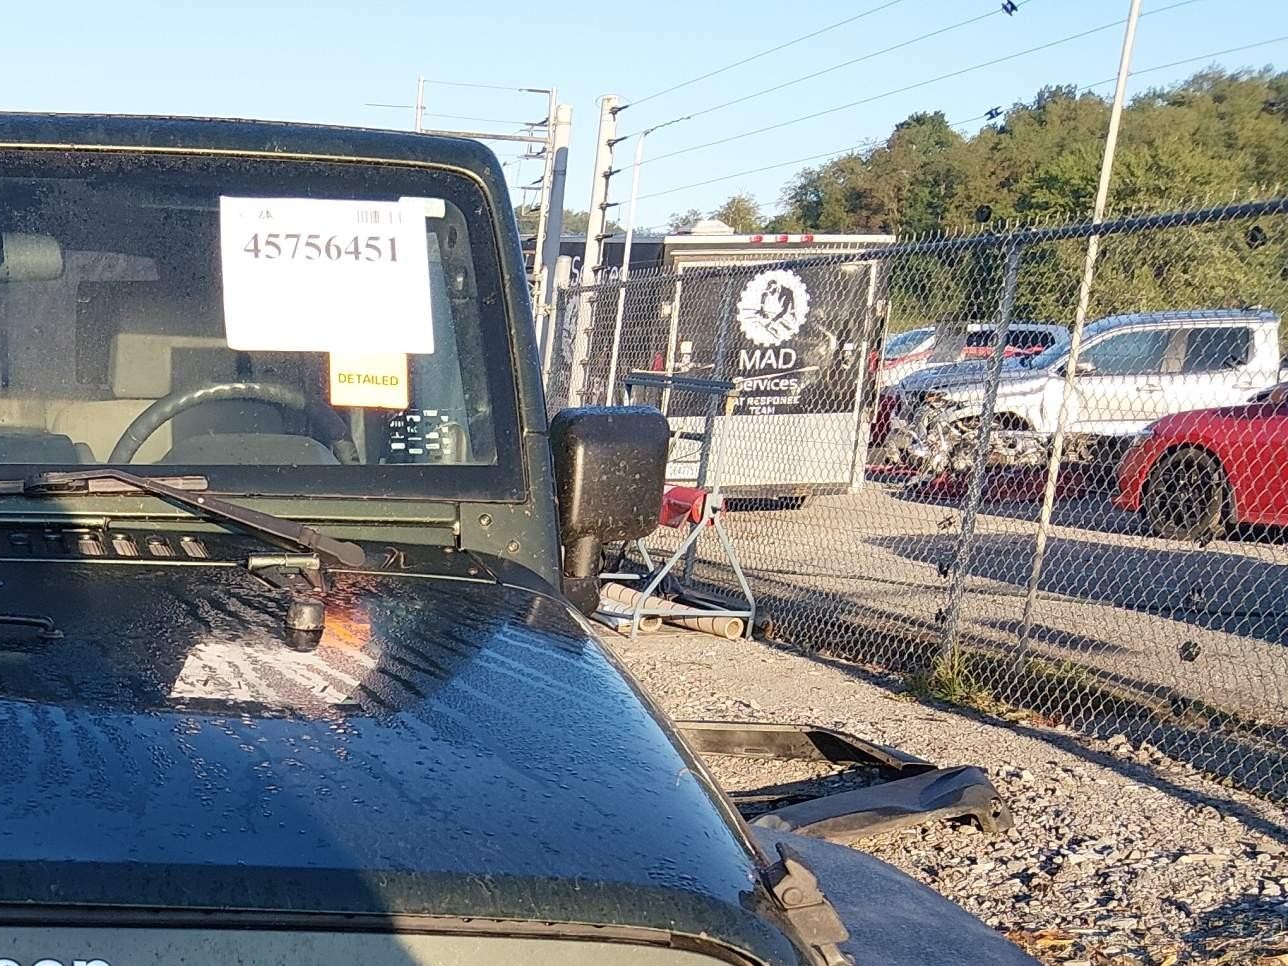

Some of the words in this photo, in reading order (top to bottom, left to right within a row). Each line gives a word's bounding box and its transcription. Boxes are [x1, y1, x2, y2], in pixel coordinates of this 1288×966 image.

[244, 233, 398, 262] 45756451
[739, 348, 797, 370] MAD
[337, 373, 399, 386] DETAILED
